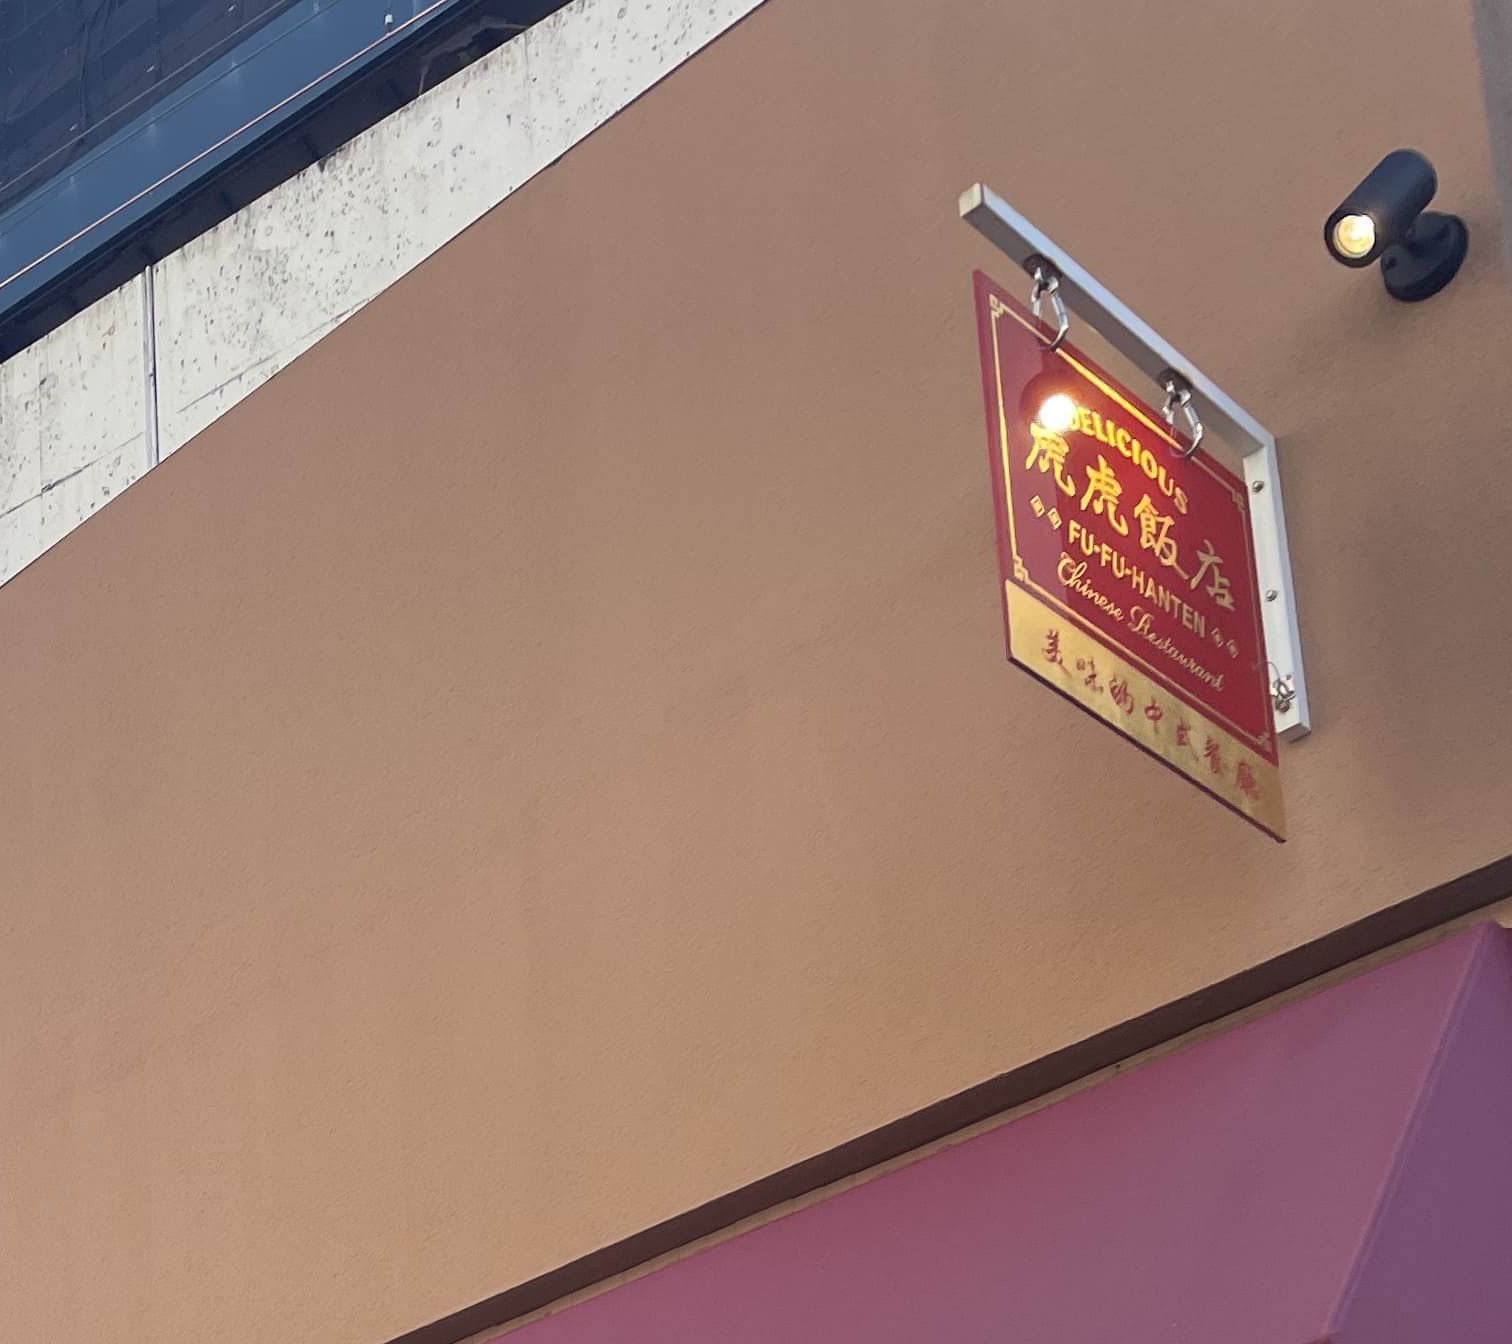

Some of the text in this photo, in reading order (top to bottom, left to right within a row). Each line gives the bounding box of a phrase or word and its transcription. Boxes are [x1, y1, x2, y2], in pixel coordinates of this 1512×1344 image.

[1025, 420, 1235, 611] 虎虎飯店
[1068, 520, 1206, 638] FU-FU-HANTEN
[1056, 551, 1225, 693] Chinese Restaurant
